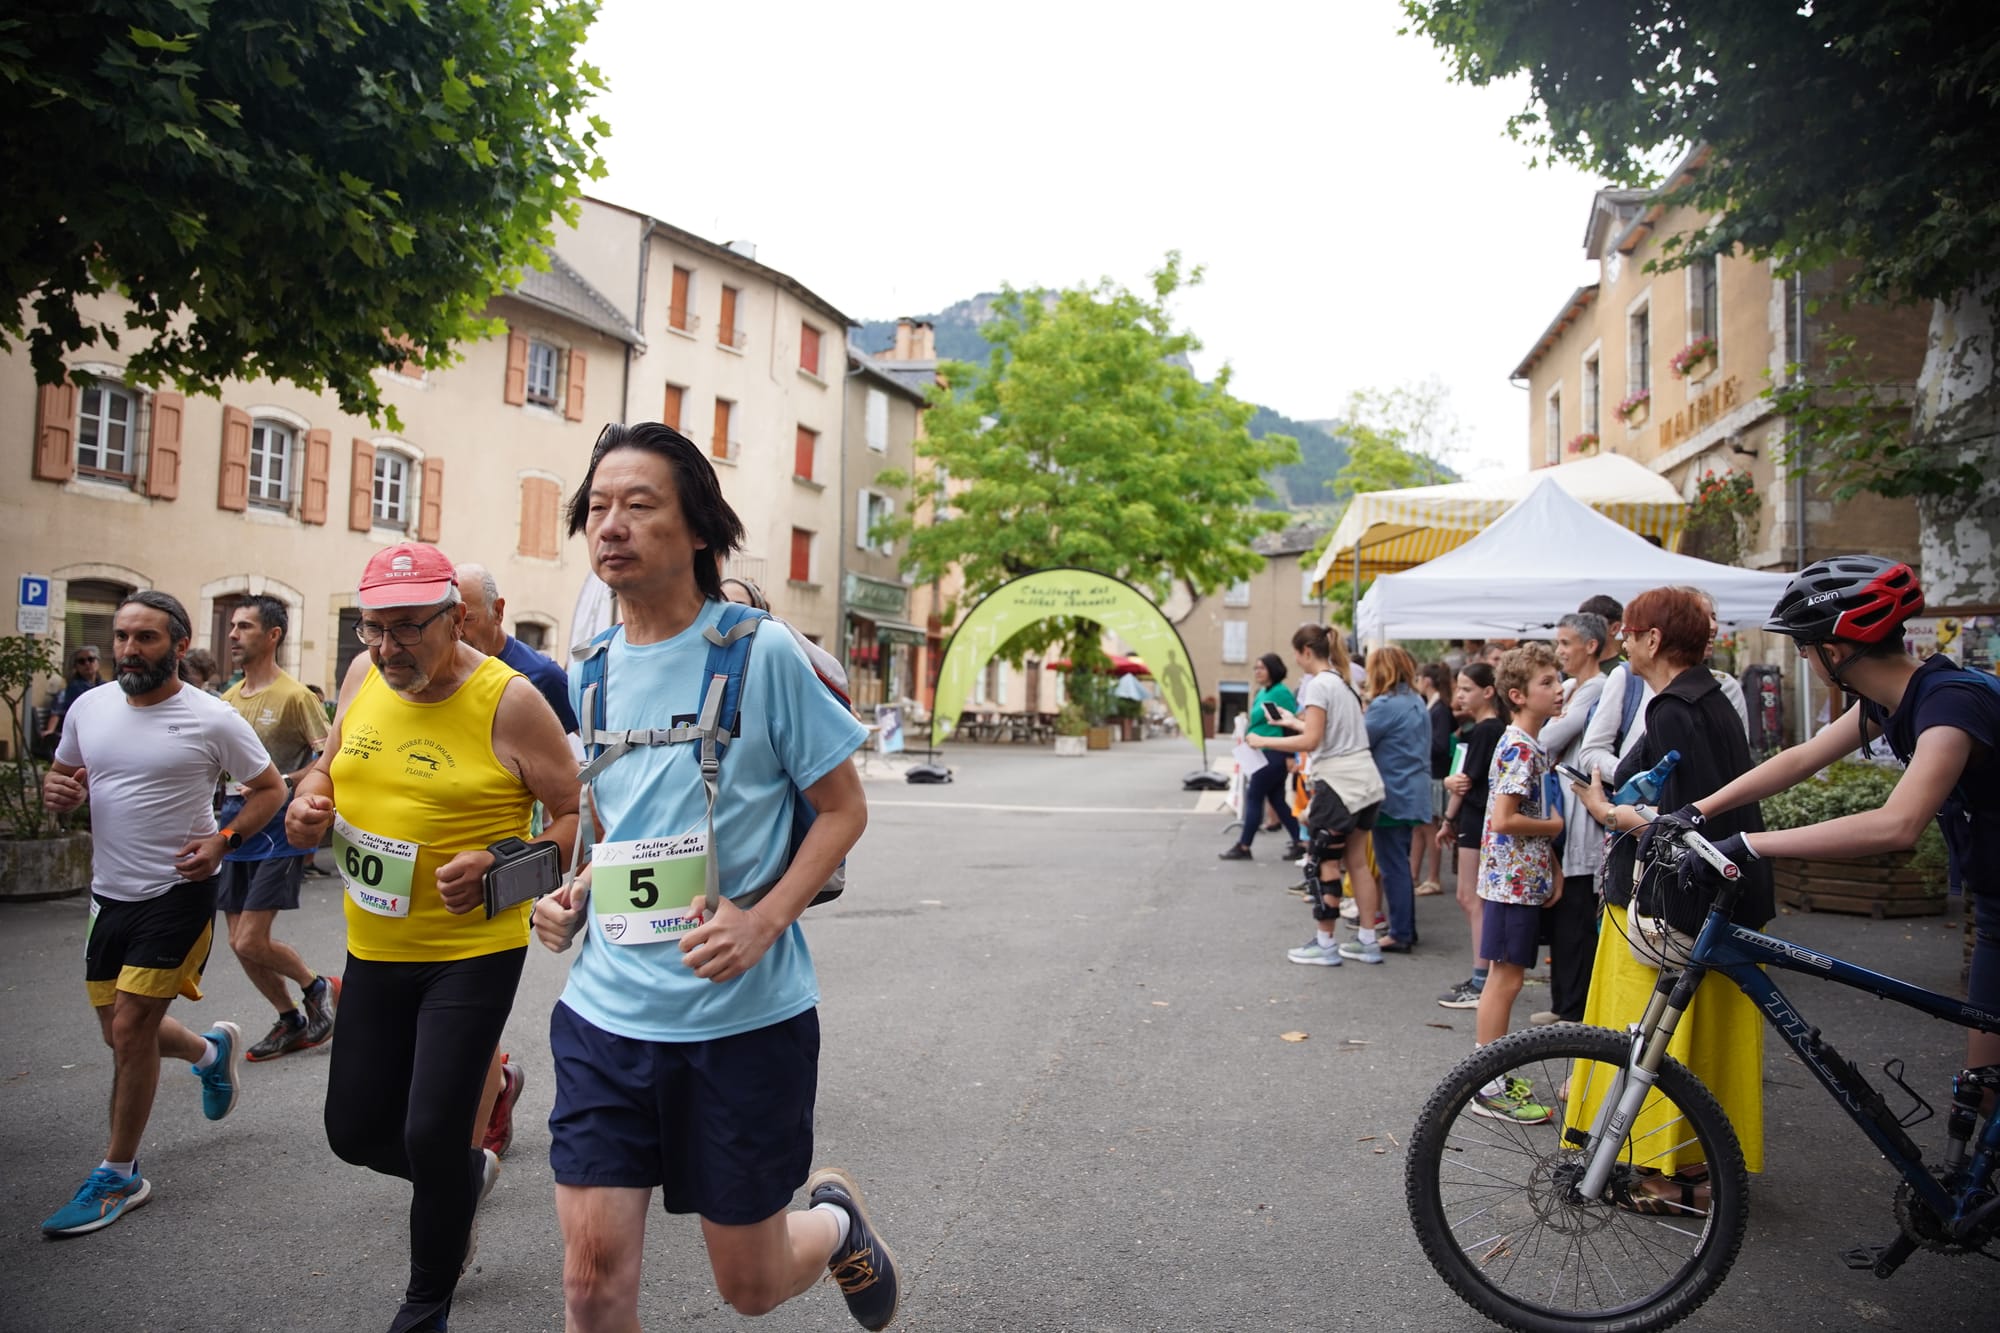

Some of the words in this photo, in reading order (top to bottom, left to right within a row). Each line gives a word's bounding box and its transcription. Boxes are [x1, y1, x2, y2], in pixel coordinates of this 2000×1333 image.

[1659, 376, 1740, 449] MAIRIE
[28, 582, 41, 602] P
[1814, 591, 1839, 604] cairn
[424, 738, 435, 747] DU
[634, 841, 675, 852] Challen
[682, 836, 699, 846] des
[345, 846, 384, 887] 60
[629, 867, 659, 909] 5
[359, 890, 388, 906] TUFF'S
[655, 922, 698, 934] Aventure
